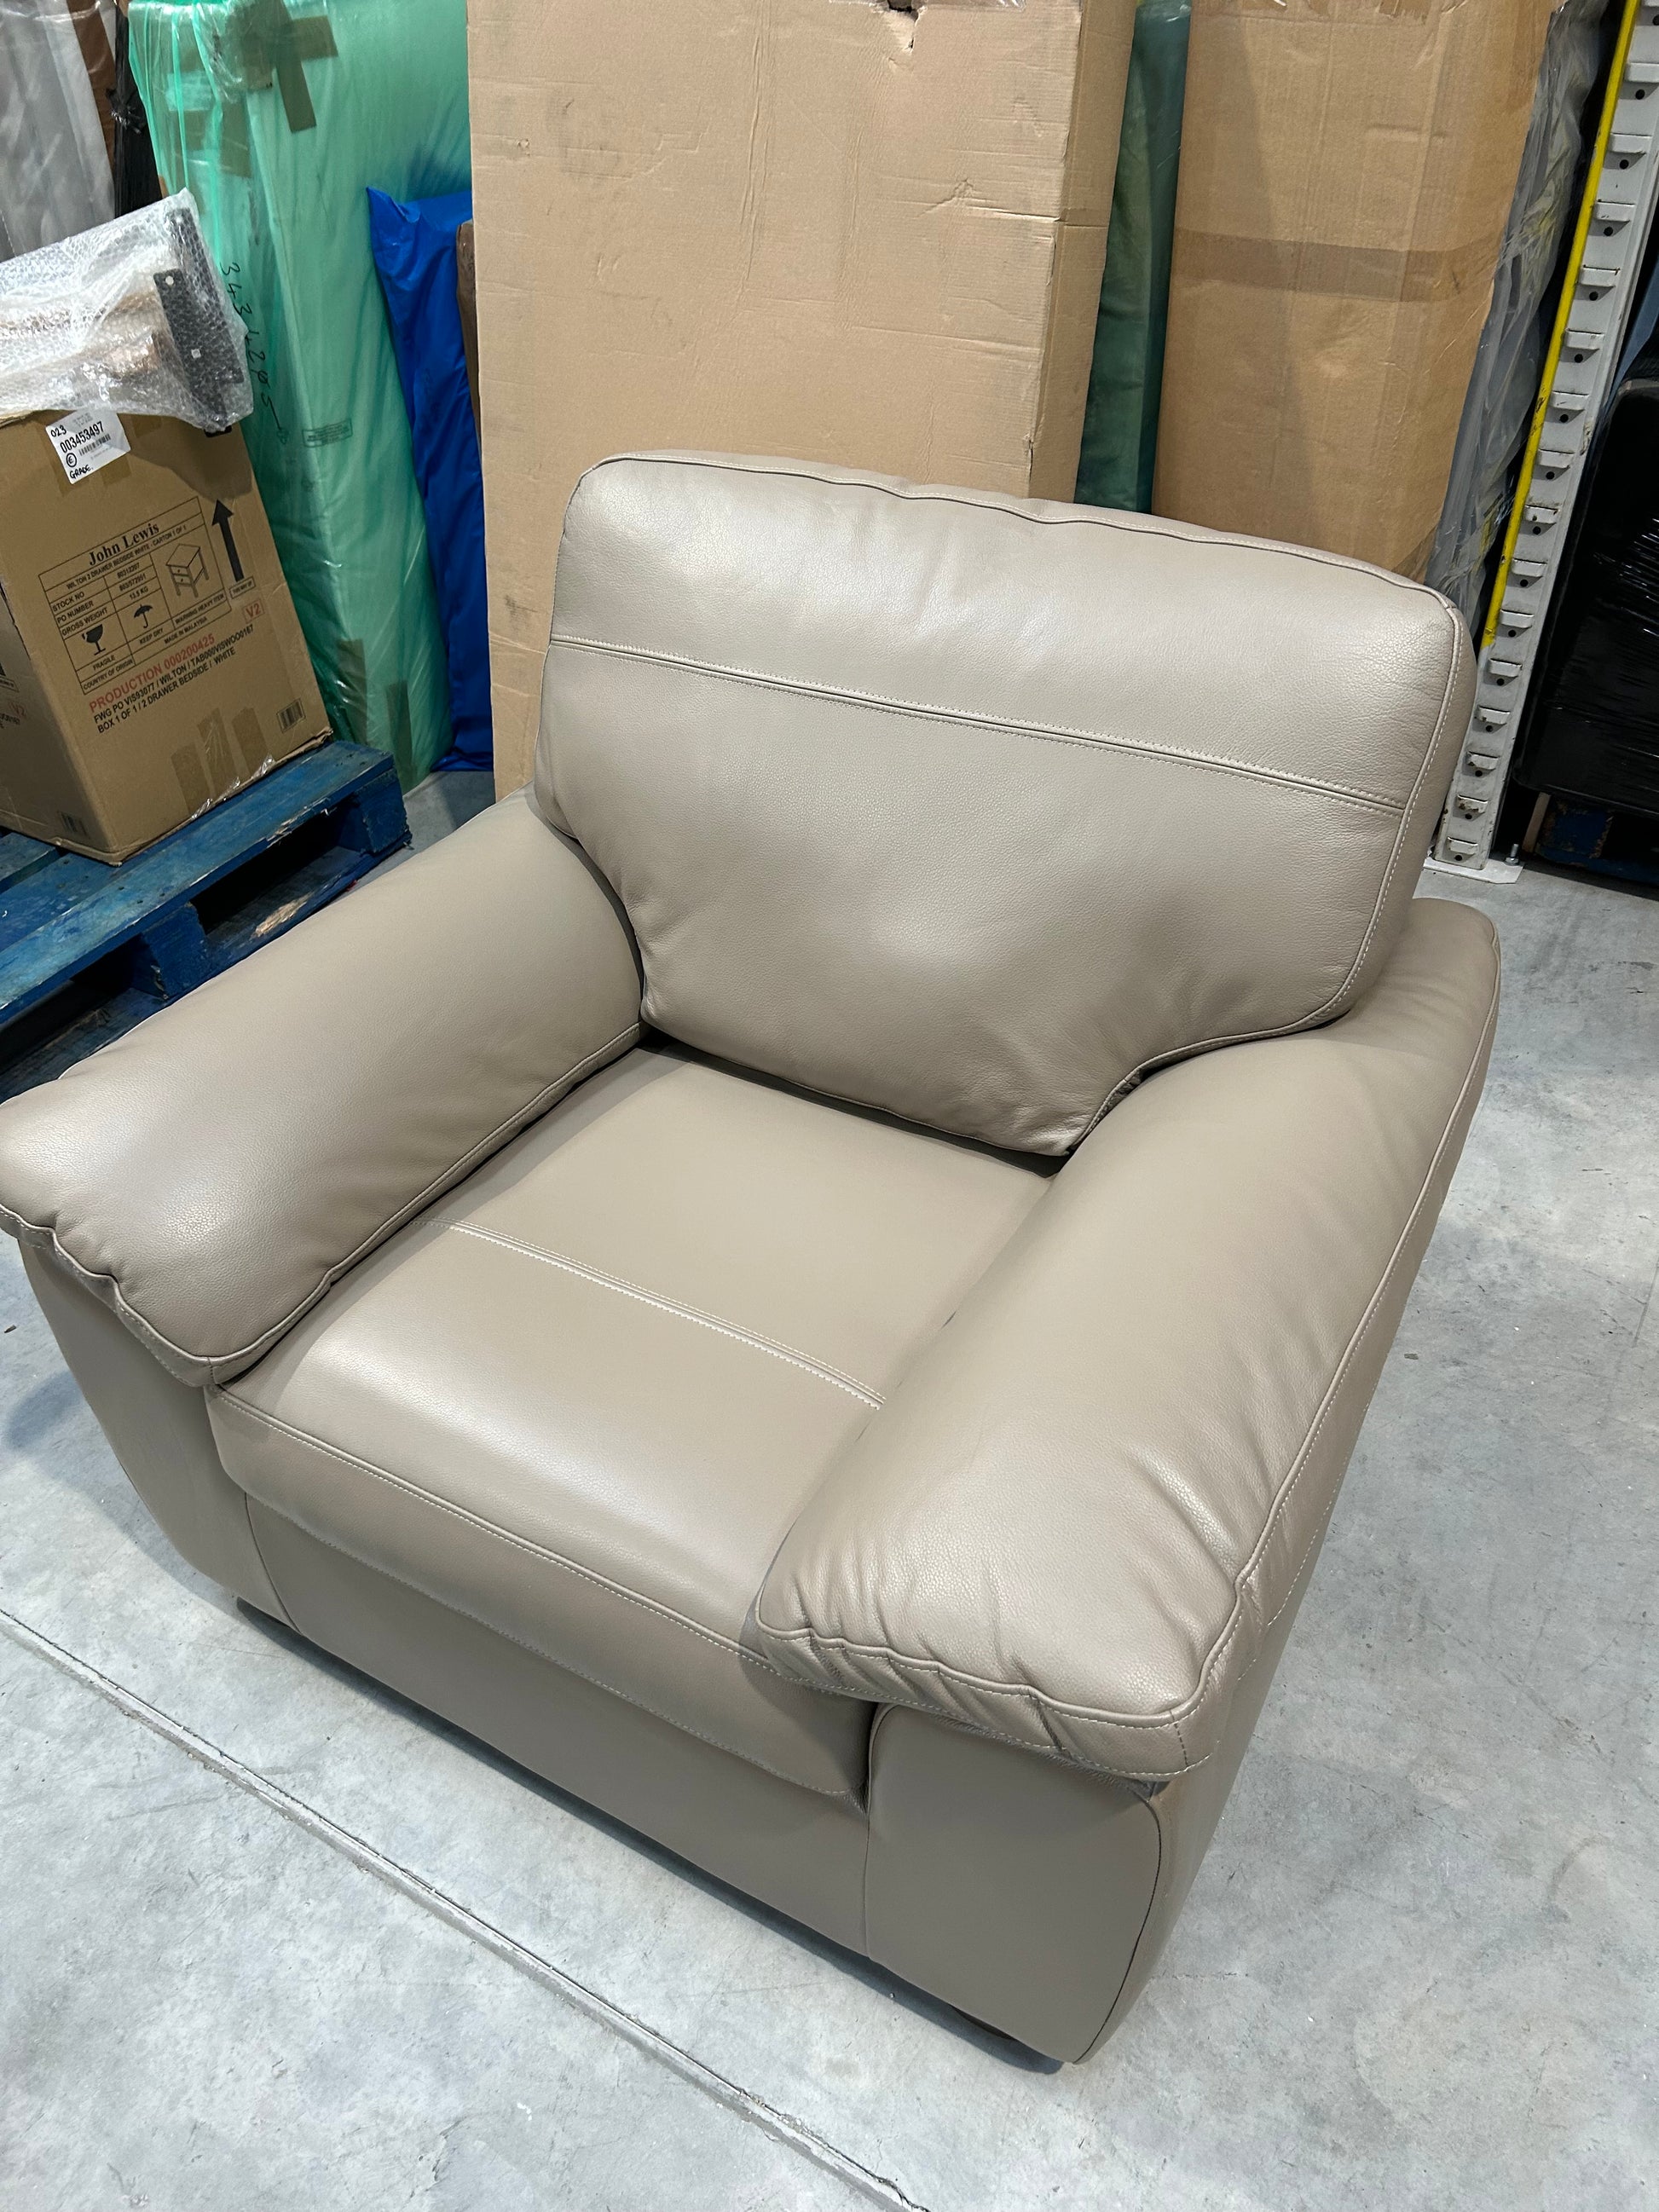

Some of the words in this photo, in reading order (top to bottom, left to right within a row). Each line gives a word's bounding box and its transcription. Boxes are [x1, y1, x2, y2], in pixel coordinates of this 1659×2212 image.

[50, 424, 67, 438] 023
[60, 420, 104, 453] 003453497
[66, 575, 88, 590] WILTON
[90, 562, 113, 578] DRAWER
[112, 551, 135, 567] BEDSIDE
[134, 543, 151, 556] WHITE
[152, 531, 173, 546] CARTON
[176, 525, 182, 534] OF
[89, 543, 121, 566] John
[121, 523, 159, 549] Lewis
[52, 596, 75, 612] STOCK
[74, 591, 85, 601] NO
[140, 586, 149, 595] KG
[56, 614, 67, 624] PO
[66, 600, 95, 619] NUMBER
[61, 620, 84, 637] GROSS
[83, 606, 108, 624] WEIGHT
[174, 608, 199, 625] WARNING
[197, 598, 213, 612] HEAVY
[213, 592, 224, 603] ITEM
[245, 603, 262, 619] V2
[139, 632, 153, 645] KEEP
[153, 627, 164, 638] DRY
[164, 632, 178, 644] MADE
[183, 615, 208, 633] MALAYSIA
[83, 672, 107, 690] COUNTRY
[107, 667, 115, 677] OF
[115, 658, 134, 673] ORIGIN
[89, 662, 163, 713] PRODUCTION
[164, 632, 215, 670] 000200425
[92, 654, 116, 671] FRAGILE
[93, 707, 113, 725] FWG
[112, 701, 124, 713] PO
[123, 682, 155, 706] VIS93077
[159, 663, 188, 685] WILTON
[97, 718, 115, 734] BOX
[120, 707, 131, 720] OF
[141, 699, 147, 708] 2
[147, 680, 179, 705] DRAWER
[178, 661, 210, 686] BEDSIDE
[213, 646, 236, 665] WHITE
